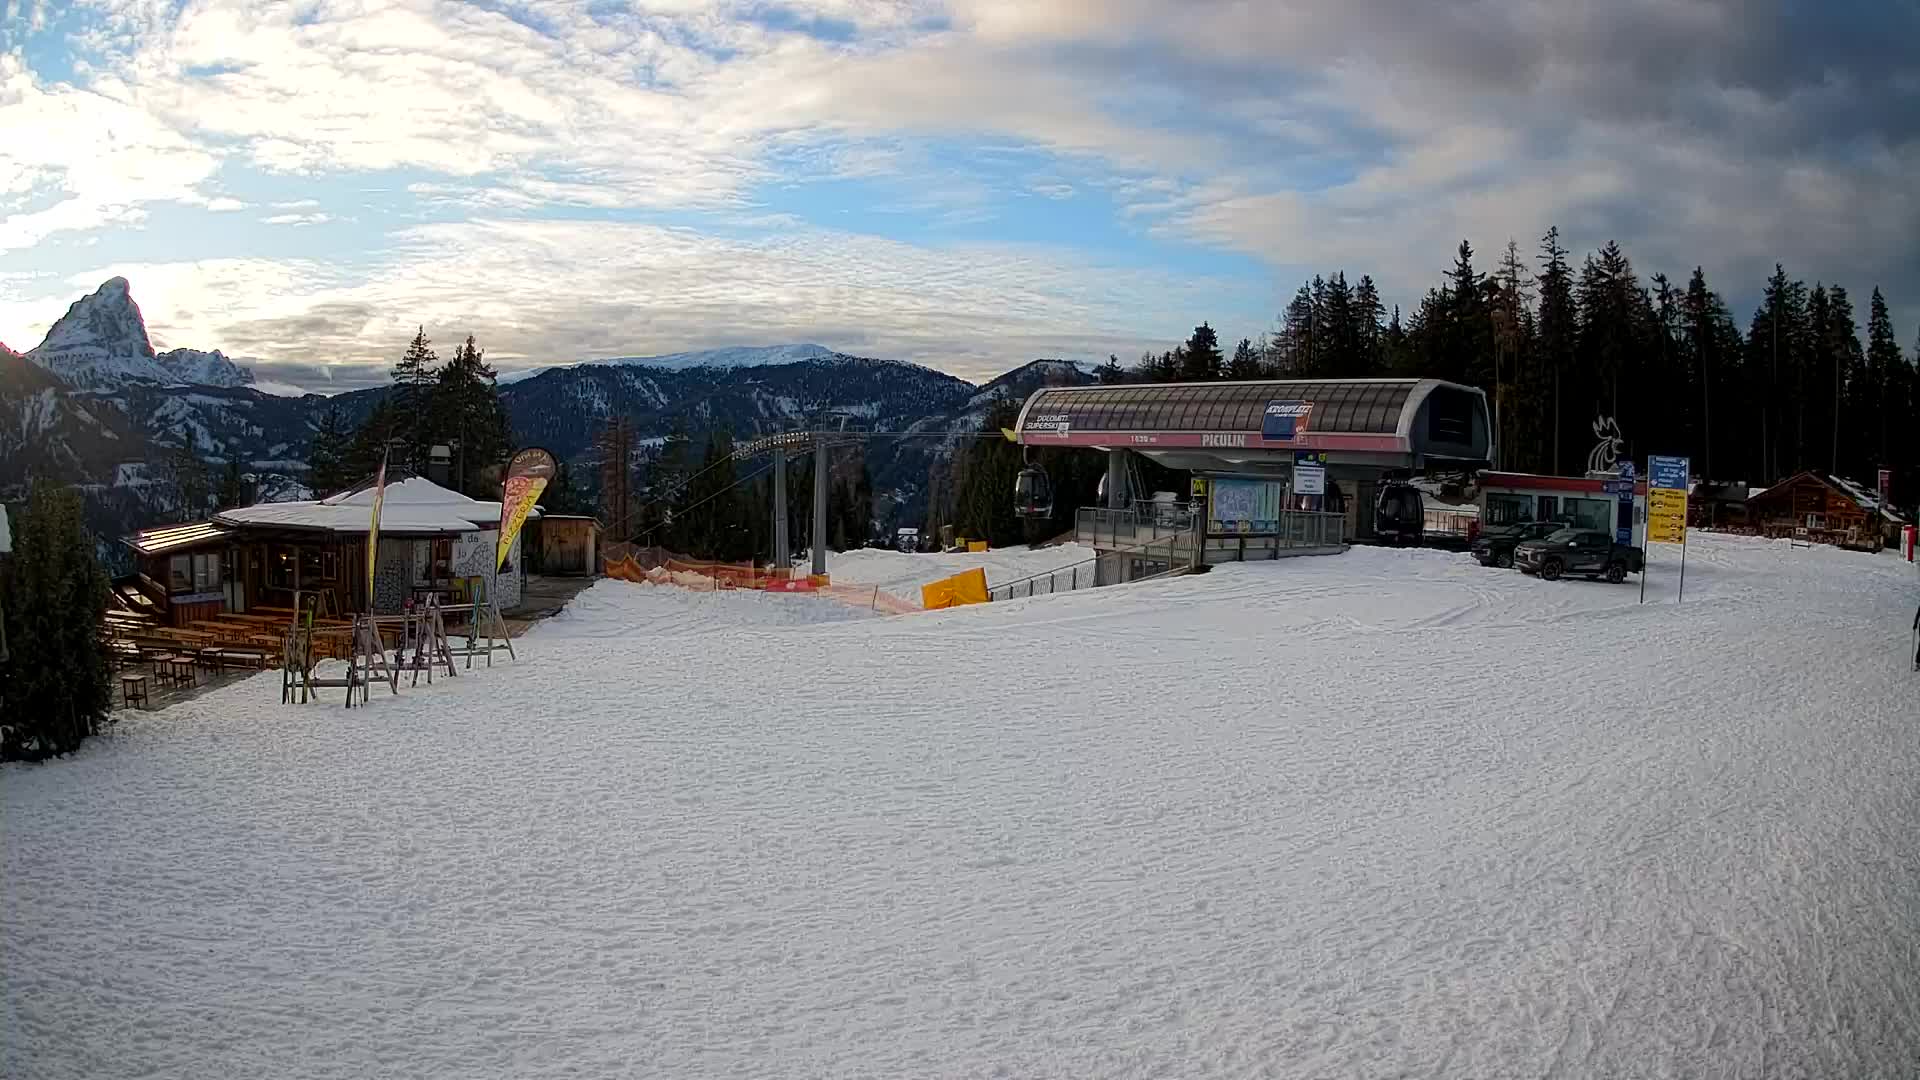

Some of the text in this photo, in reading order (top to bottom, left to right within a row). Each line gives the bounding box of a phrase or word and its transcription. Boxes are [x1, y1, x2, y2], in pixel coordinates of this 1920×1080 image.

[1037, 414, 1068, 423] DOLOMITI
[1025, 422, 1058, 430] SUPERSKI
[1201, 434, 1245, 447] PICULIN
[503, 495, 536, 545] PIZZERIA
